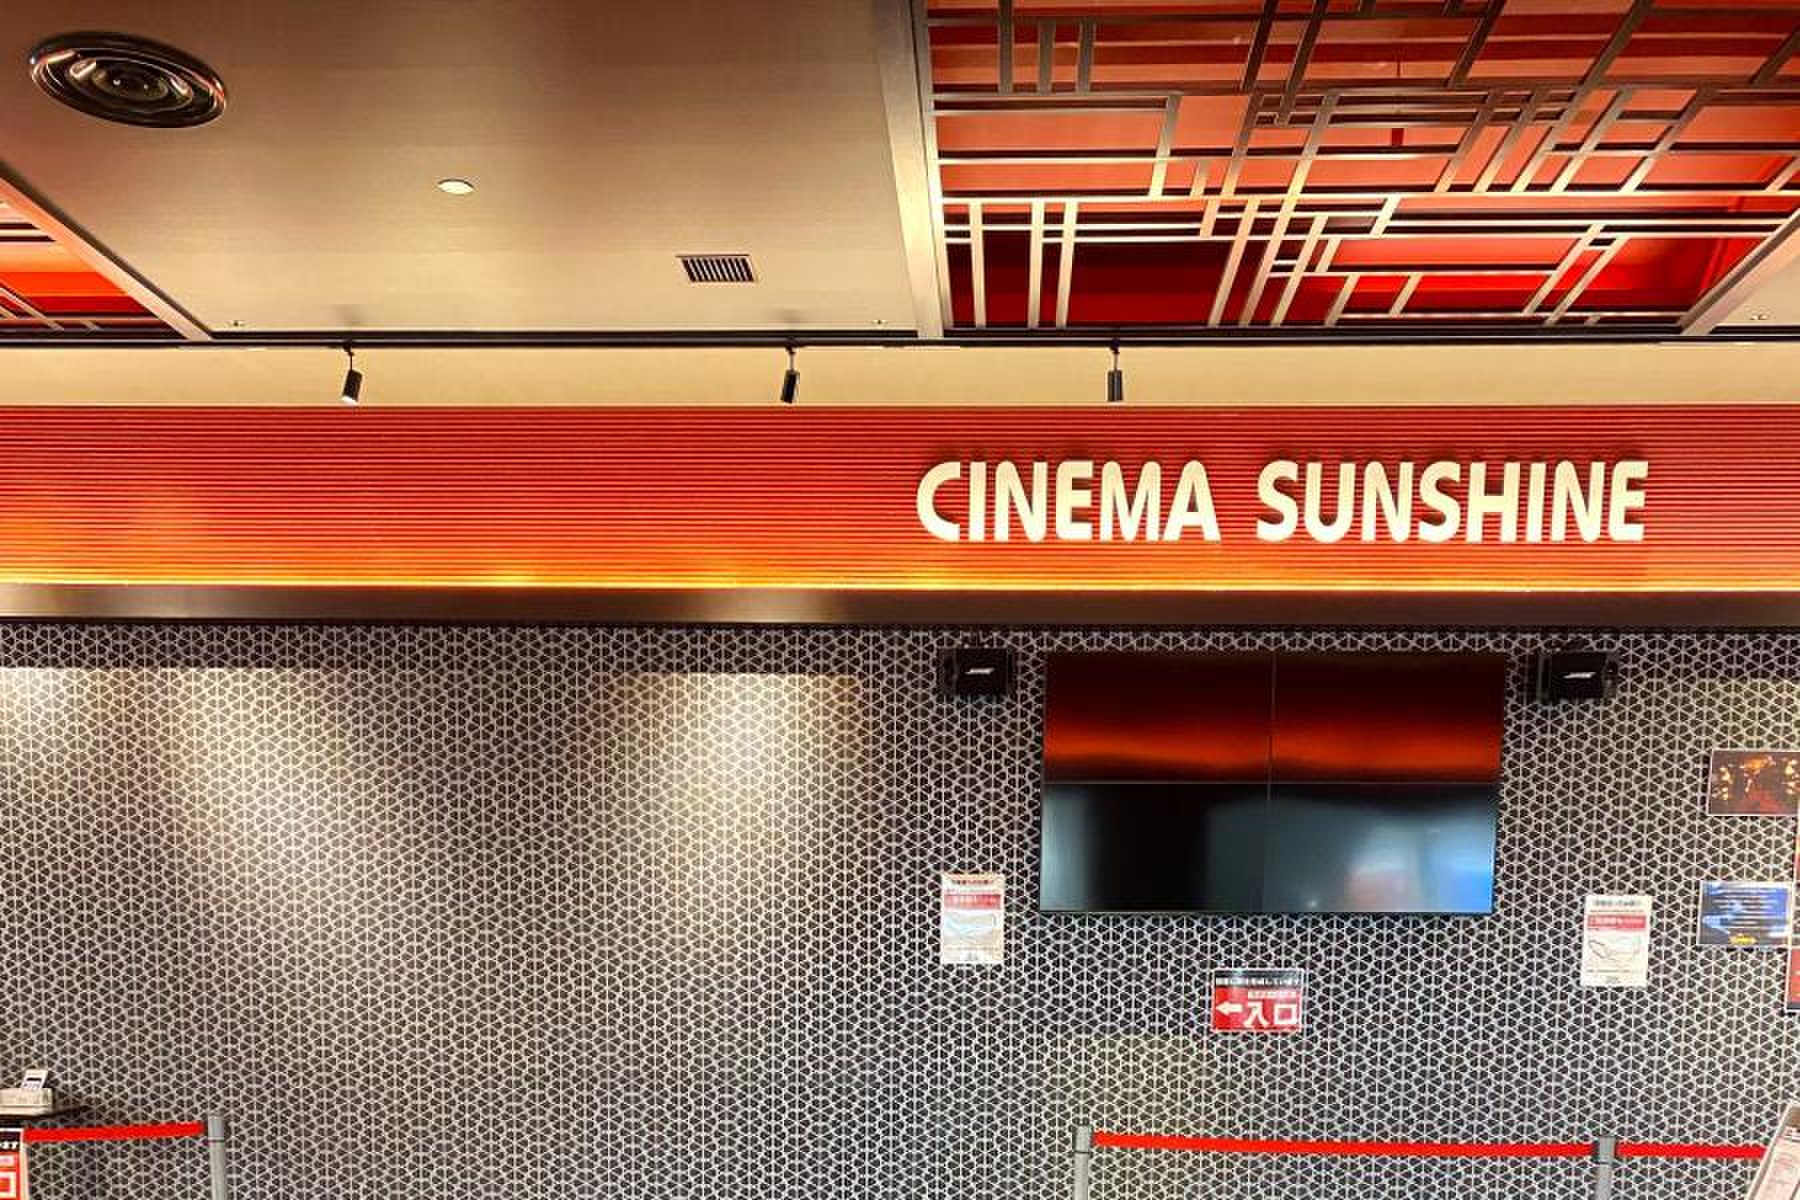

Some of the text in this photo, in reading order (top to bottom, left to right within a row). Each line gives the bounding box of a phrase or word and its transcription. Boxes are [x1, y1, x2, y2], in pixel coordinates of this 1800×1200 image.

[916, 459, 1649, 544] CINEMA SUNSHINE
[1243, 1001, 1298, 1027] 入口
